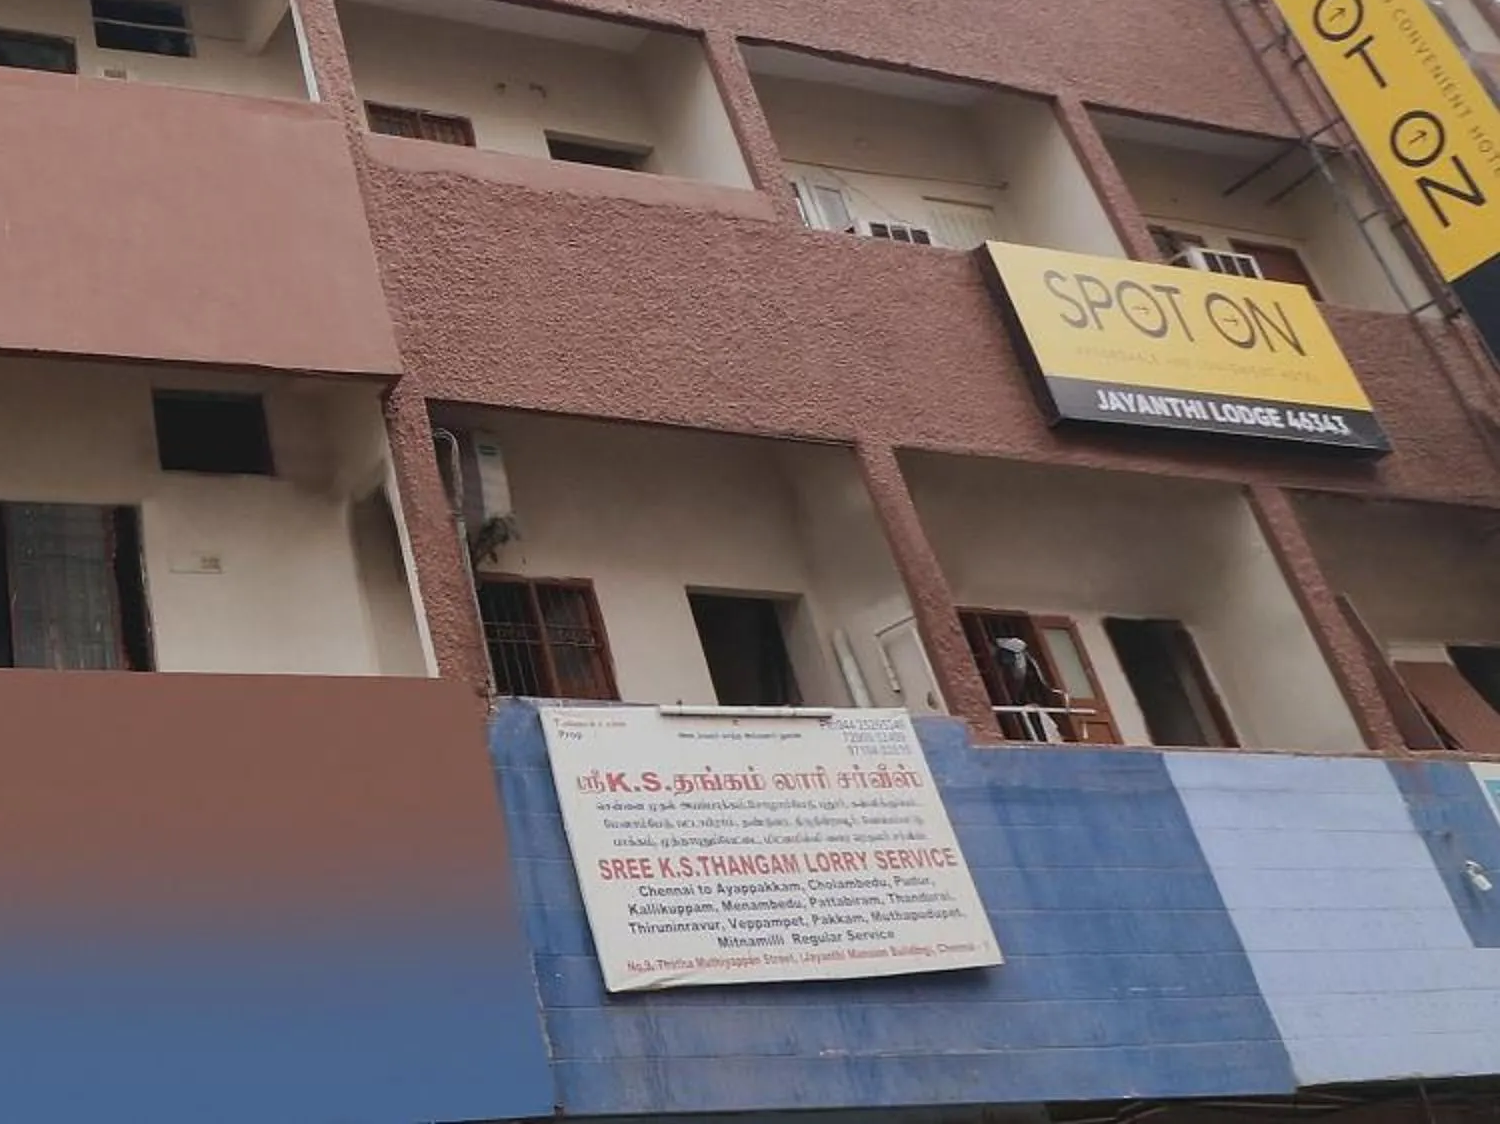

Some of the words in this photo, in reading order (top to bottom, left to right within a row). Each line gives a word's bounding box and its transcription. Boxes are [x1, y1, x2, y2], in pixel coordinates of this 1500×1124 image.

[1393, 8, 1473, 118] CONVENIENT
[1389, 109, 1486, 229] ON
[1043, 269, 1196, 343] SPOT
[1205, 292, 1308, 357] ON
[1096, 389, 1208, 422] JAYANTHI
[1208, 401, 1285, 429] LODGE
[1286, 410, 1350, 436] 46343
[598, 858, 654, 880] SREE
[804, 851, 869, 874] LORRY
[874, 847, 958, 870] SERVICE
[638, 884, 694, 897] Chennai
[698, 884, 712, 895] to
[791, 931, 842, 946] Regular
[847, 929, 895, 942] Service
